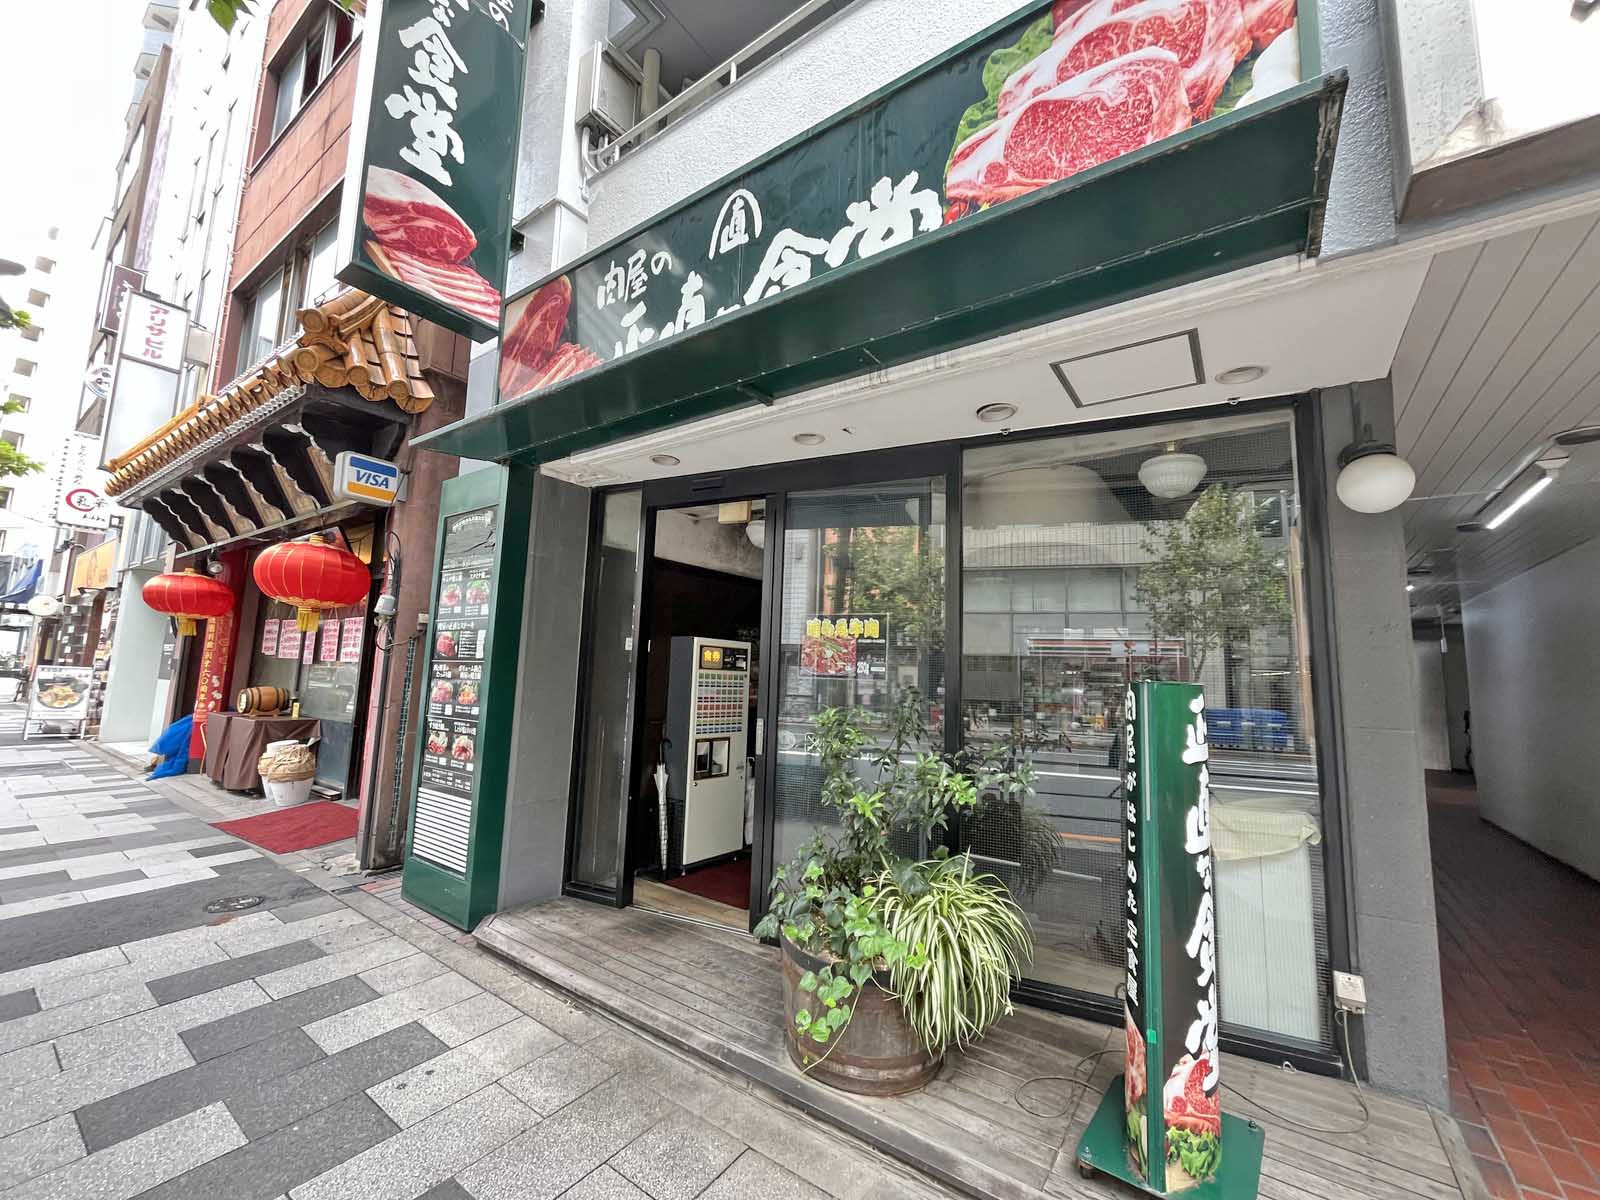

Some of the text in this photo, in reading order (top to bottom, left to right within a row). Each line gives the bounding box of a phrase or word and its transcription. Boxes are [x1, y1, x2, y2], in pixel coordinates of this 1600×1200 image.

[596, 248, 672, 311] 肉屋の
[612, 170, 943, 360] 正直食堂
[355, 469, 389, 489] VISA
[703, 650, 721, 663] 食券
